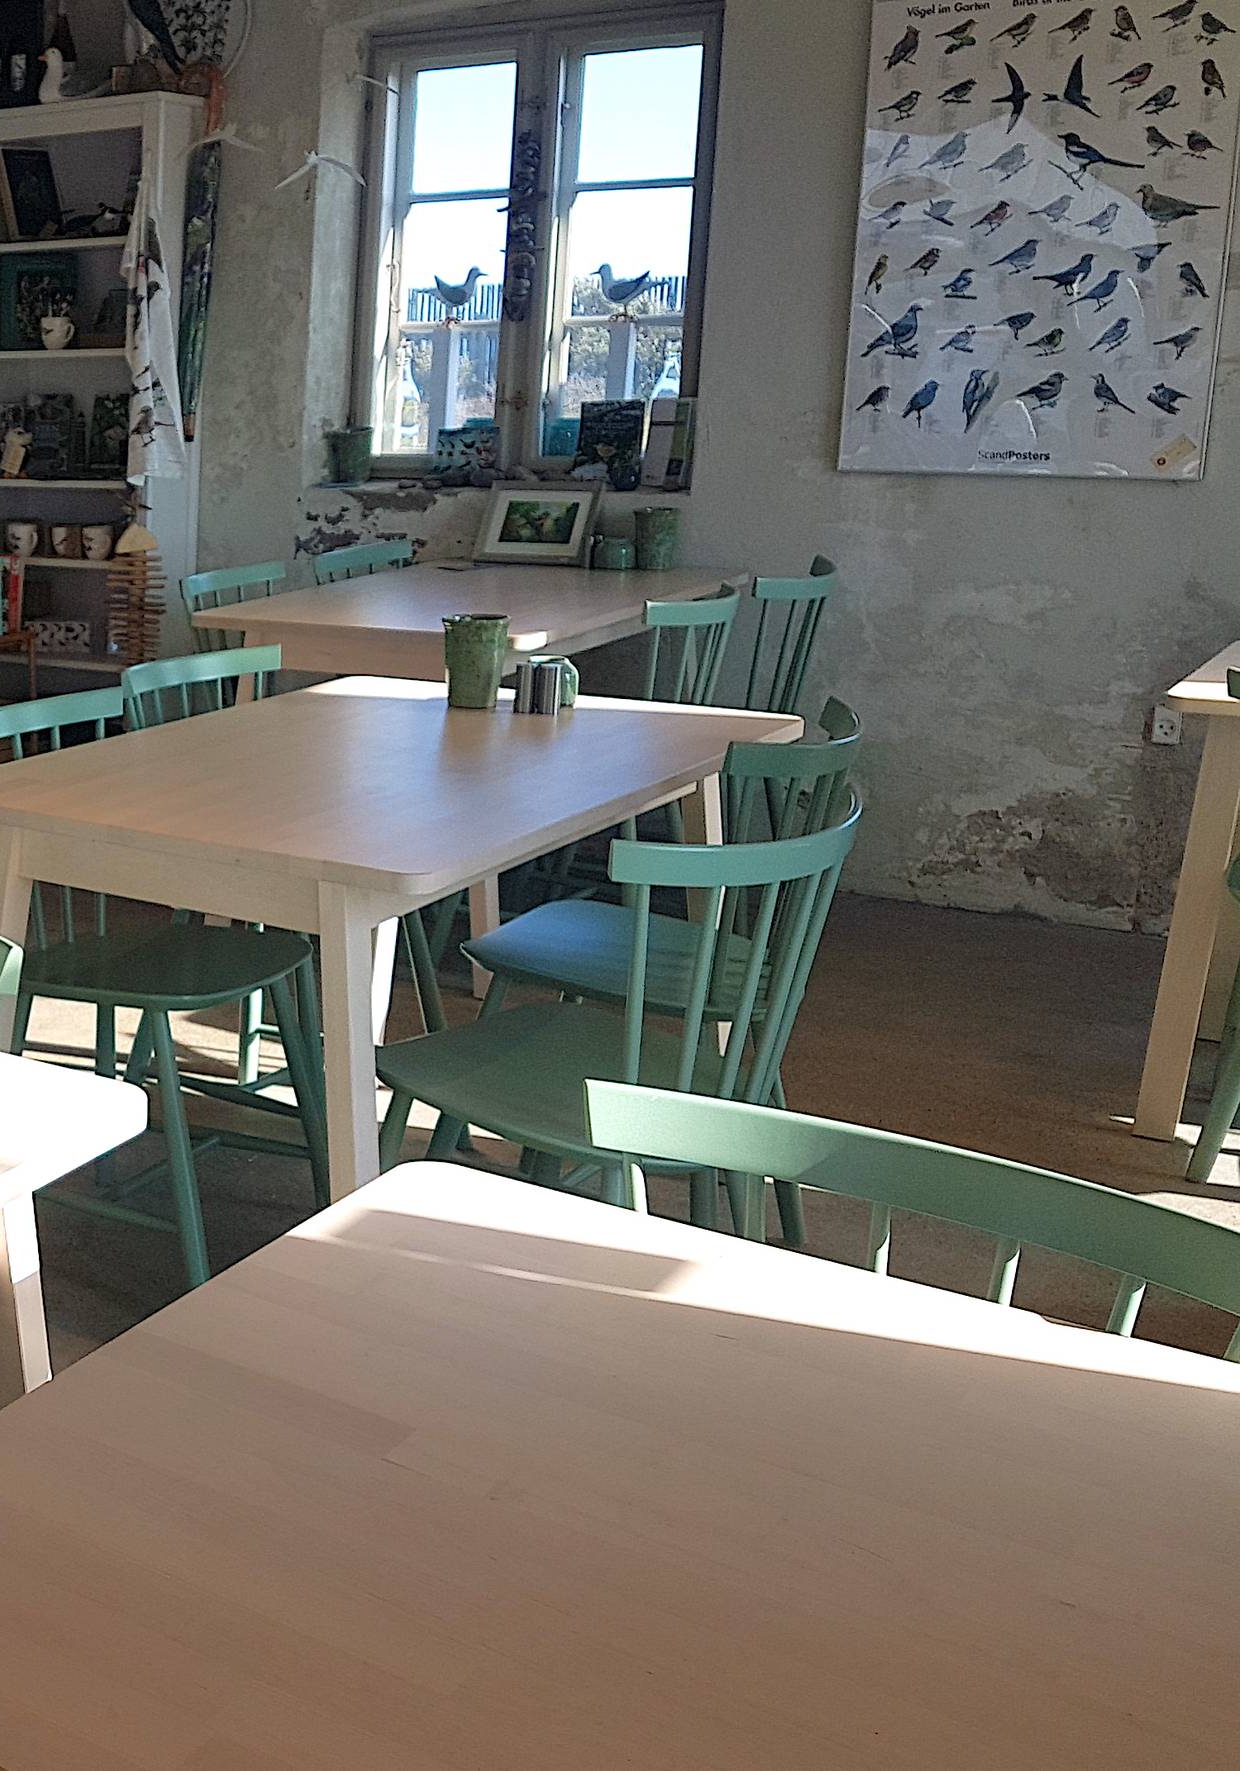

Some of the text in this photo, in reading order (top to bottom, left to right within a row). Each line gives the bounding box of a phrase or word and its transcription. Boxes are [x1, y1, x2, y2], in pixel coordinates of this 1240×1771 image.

[906, 2, 991, 18] Vögel im Garten
[978, 450, 1050, 461] ScandPosters
